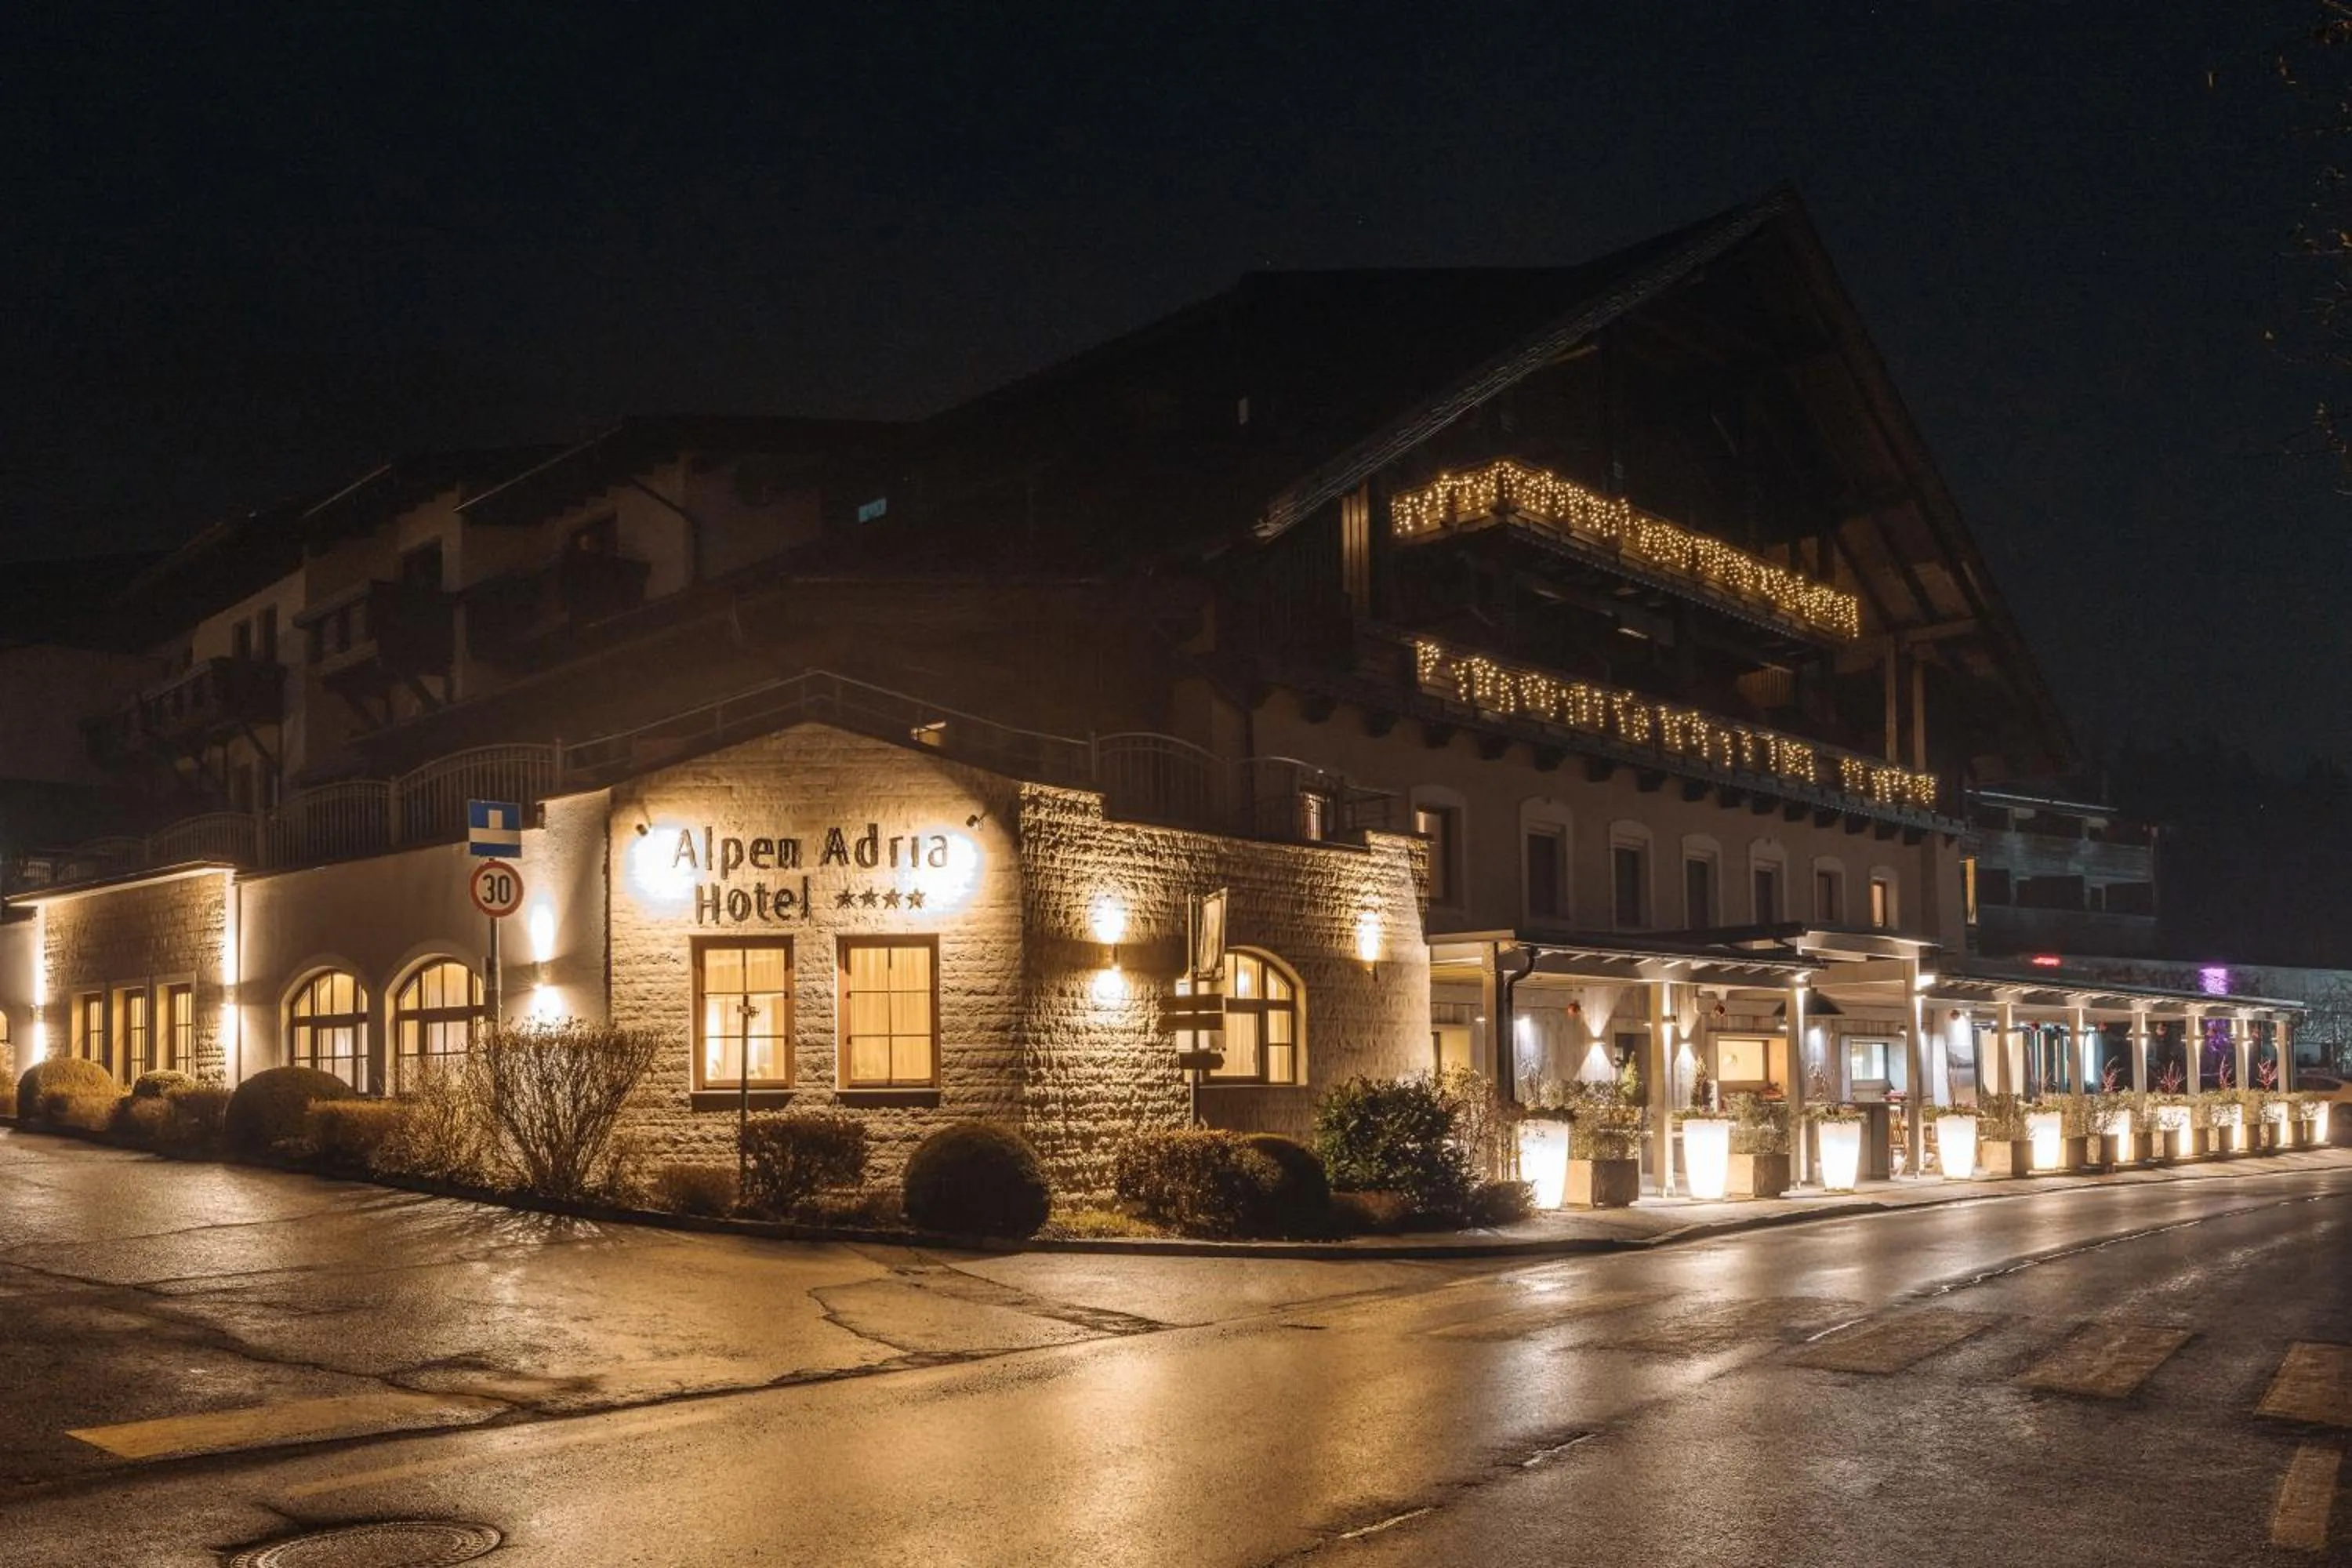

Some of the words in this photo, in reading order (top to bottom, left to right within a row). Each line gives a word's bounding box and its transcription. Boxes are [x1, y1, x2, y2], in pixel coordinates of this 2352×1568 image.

[673, 826, 802, 879] Alpen
[819, 823, 948, 868] Adria
[482, 874, 510, 904] 30
[695, 877, 810, 924] Hotel
